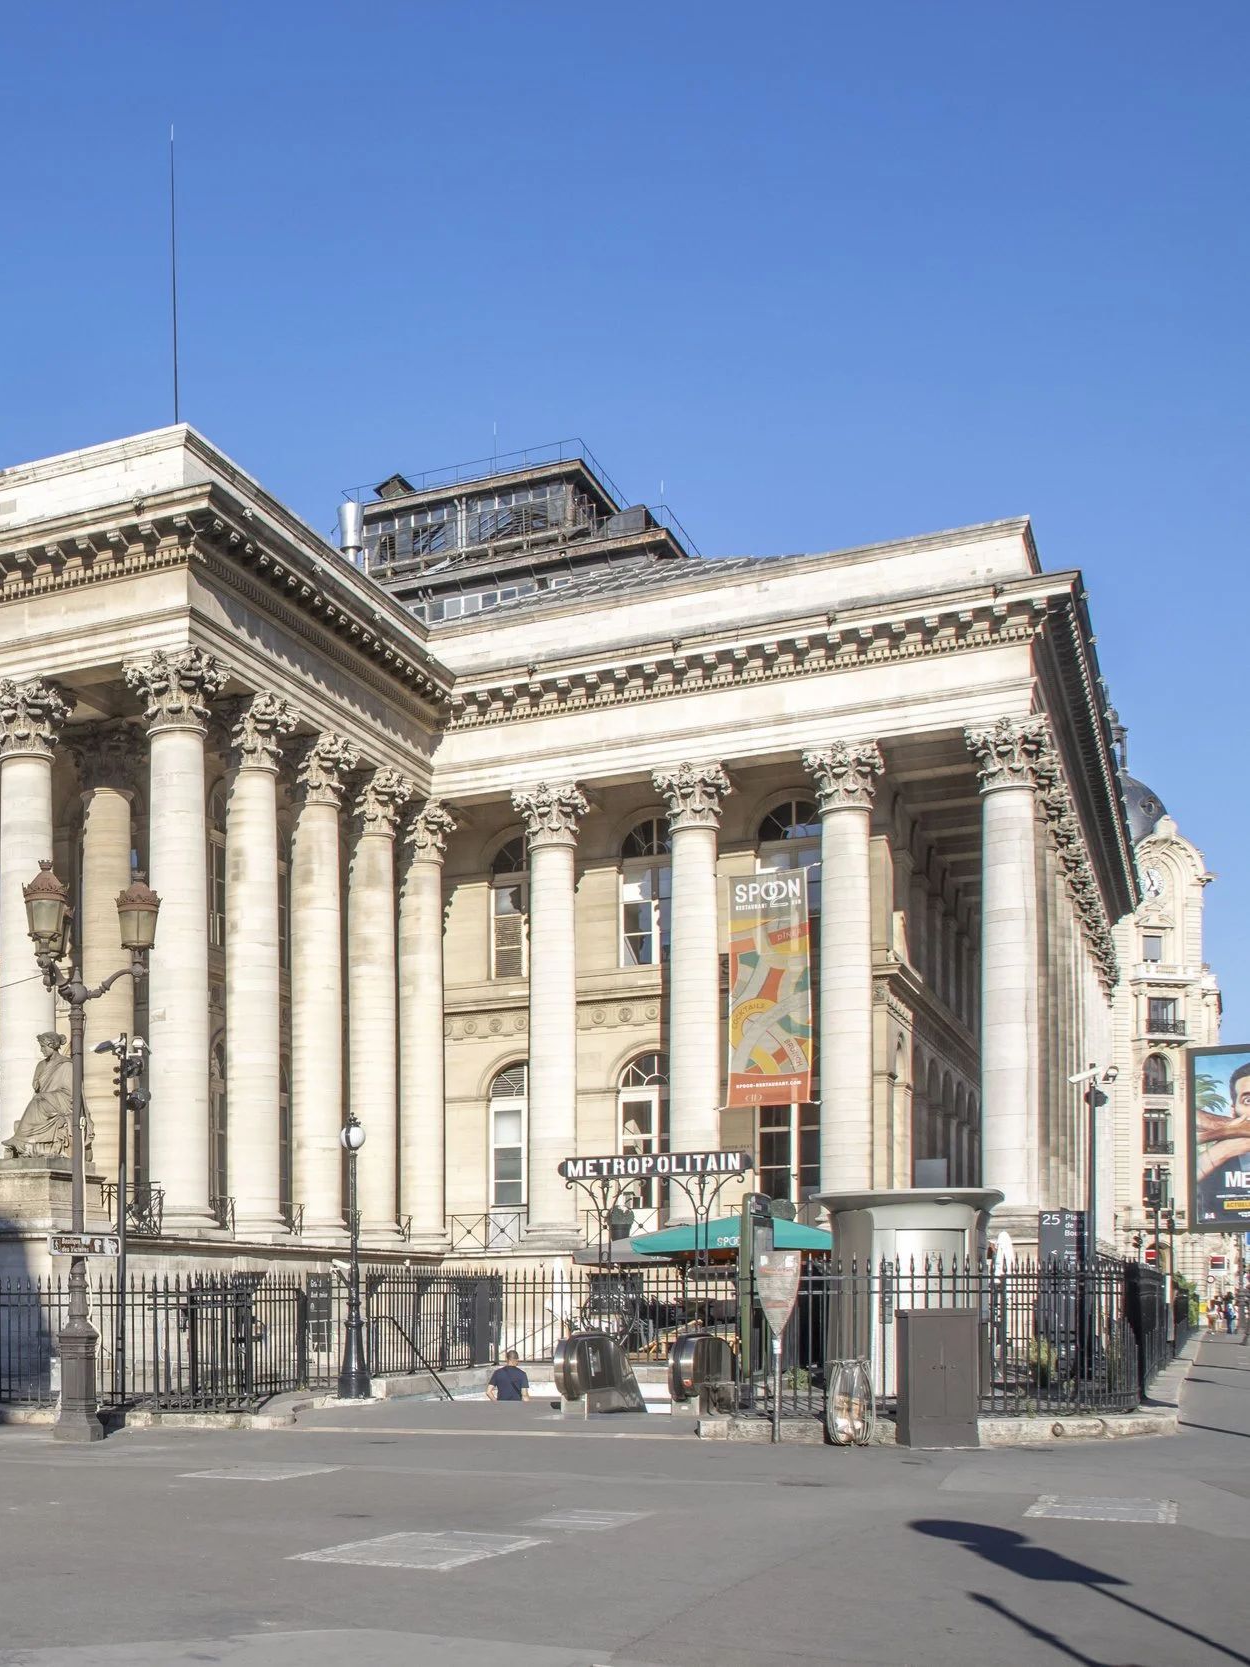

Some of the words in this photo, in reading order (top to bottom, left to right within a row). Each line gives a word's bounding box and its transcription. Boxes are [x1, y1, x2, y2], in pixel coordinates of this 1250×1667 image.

[735, 903, 768, 911] RESTAURANT
[732, 1003, 765, 1030] COCKTAILS
[784, 1038, 803, 1067] BRUNCH
[567, 1152, 741, 1178] METROPOLITAIN
[1225, 1170, 1250, 1188] ME
[1042, 1214, 1061, 1226] 25
[1064, 1221, 1075, 1229] de
